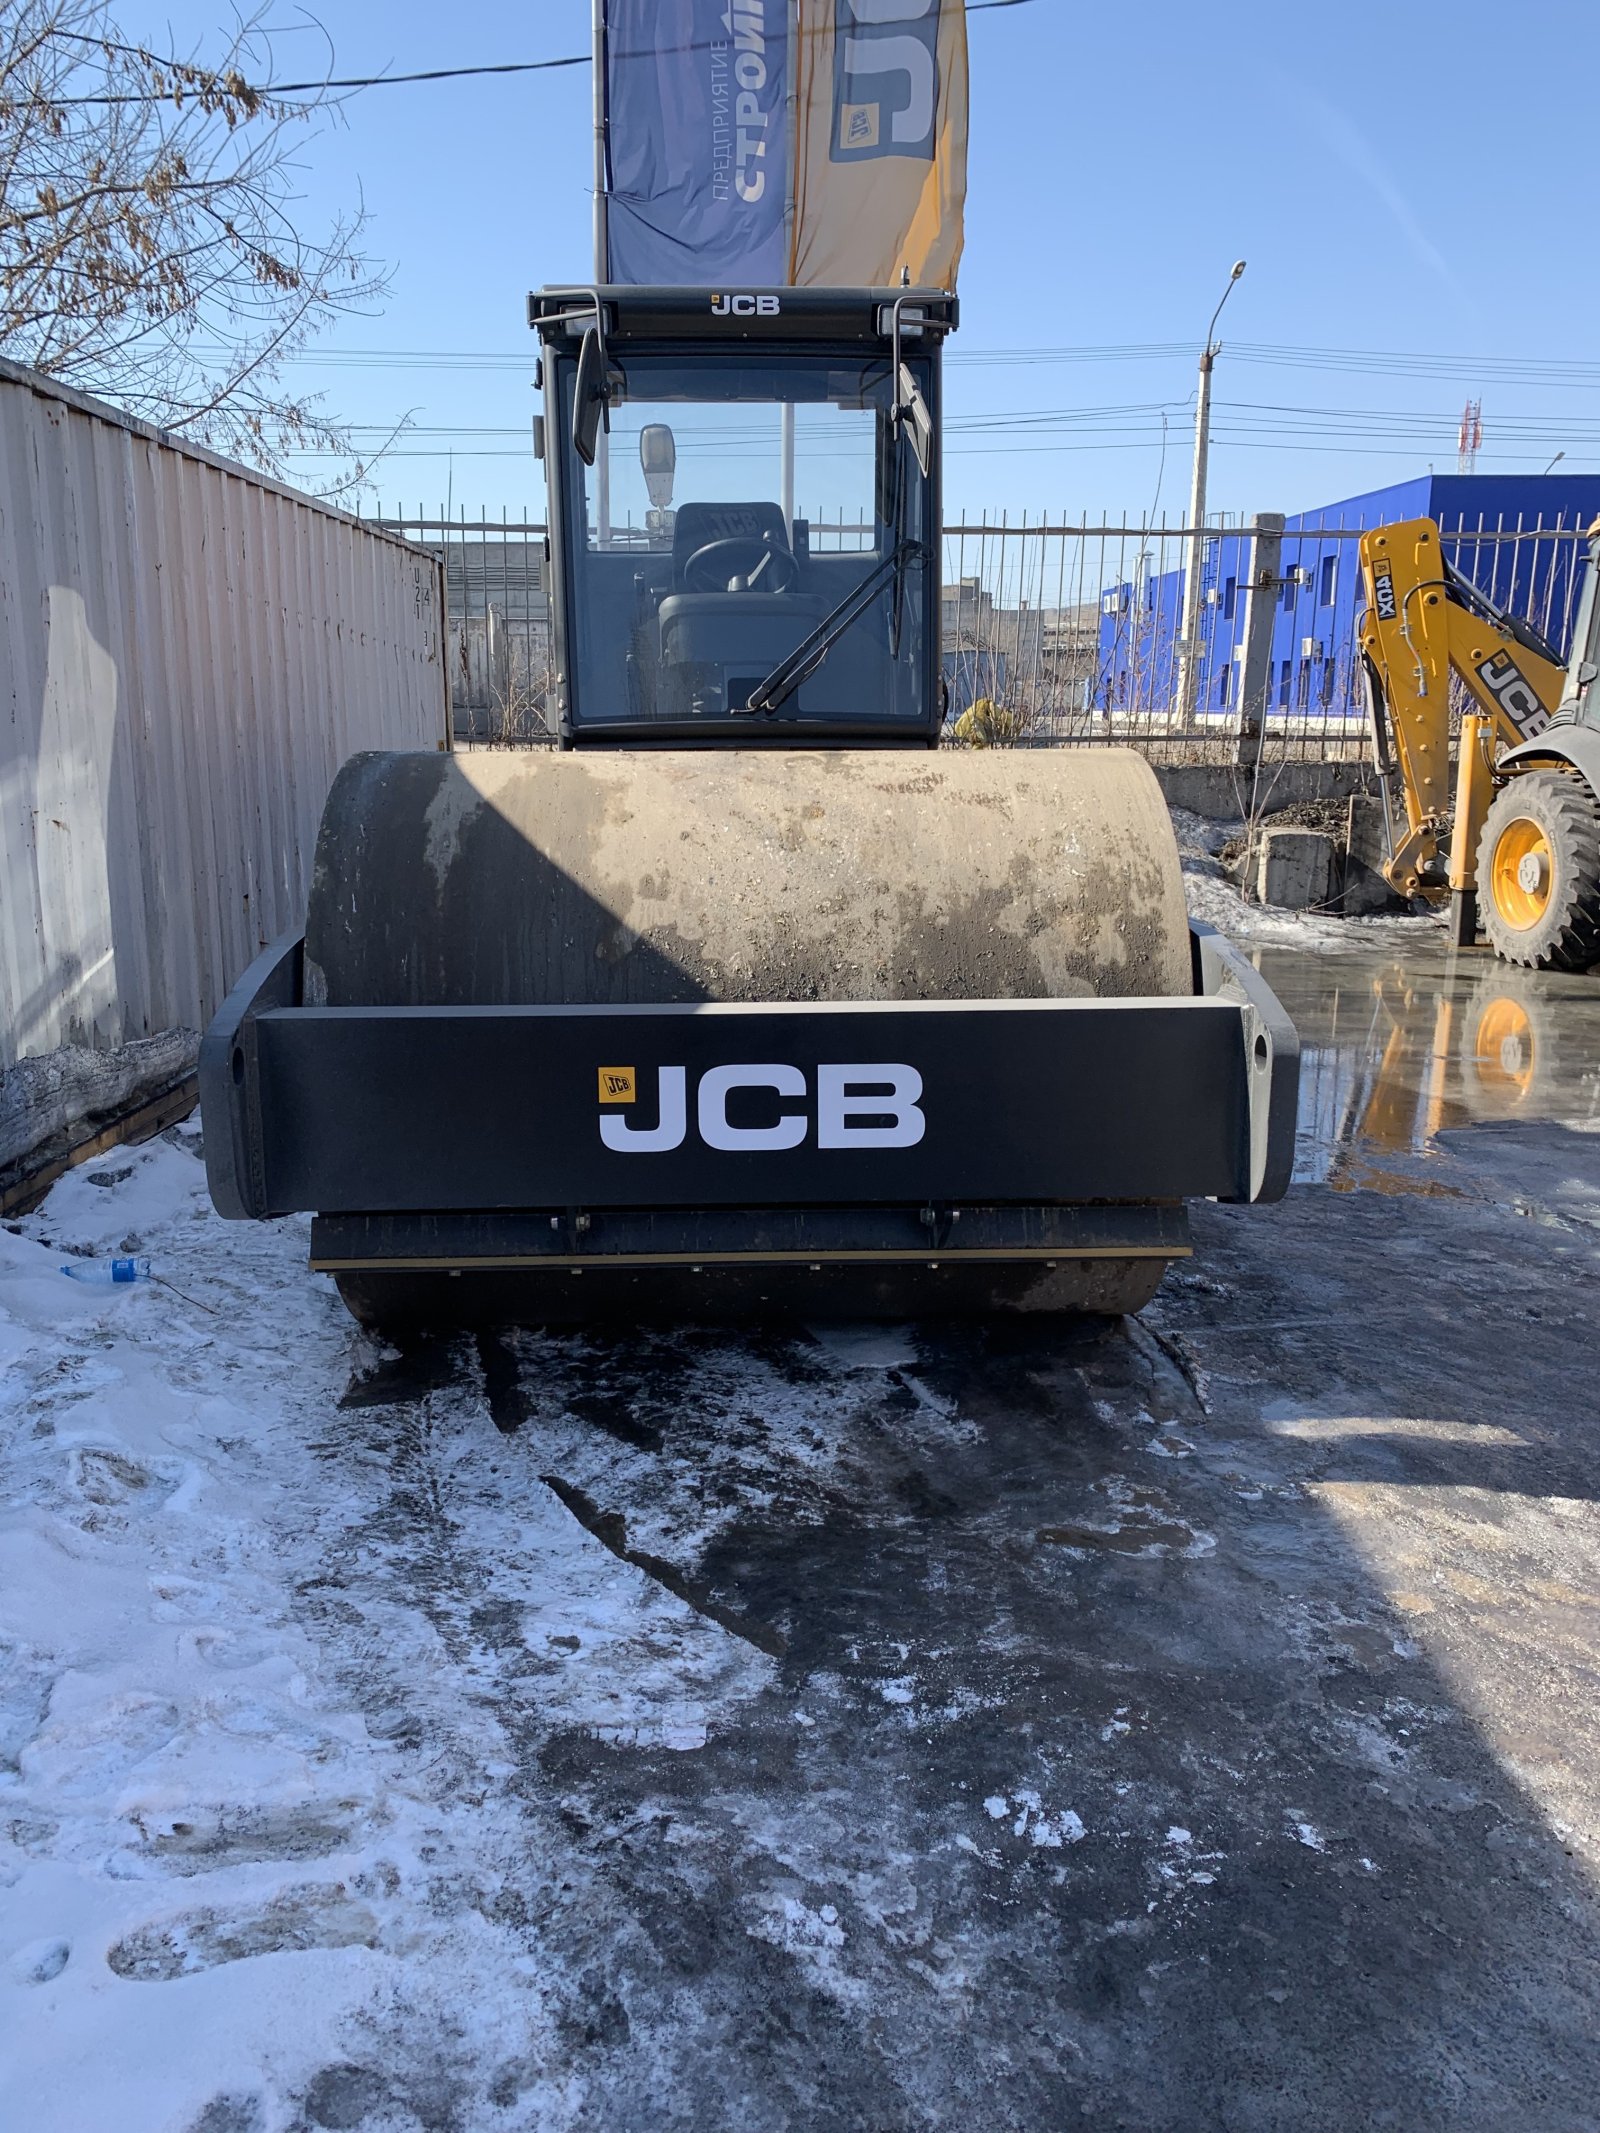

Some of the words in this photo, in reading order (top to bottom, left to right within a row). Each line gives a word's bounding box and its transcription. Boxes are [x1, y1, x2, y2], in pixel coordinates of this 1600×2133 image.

[844, 0, 934, 143] J
[711, 40, 732, 201] ПРЕДПРИЯТИЕ
[850, 110, 870, 138] JCB
[711, 295, 780, 316] JCB
[708, 511, 759, 539] JCB
[1376, 575, 1396, 616] 4CX
[608, 1076, 630, 1094] JCB
[600, 1063, 926, 1152] JCB
